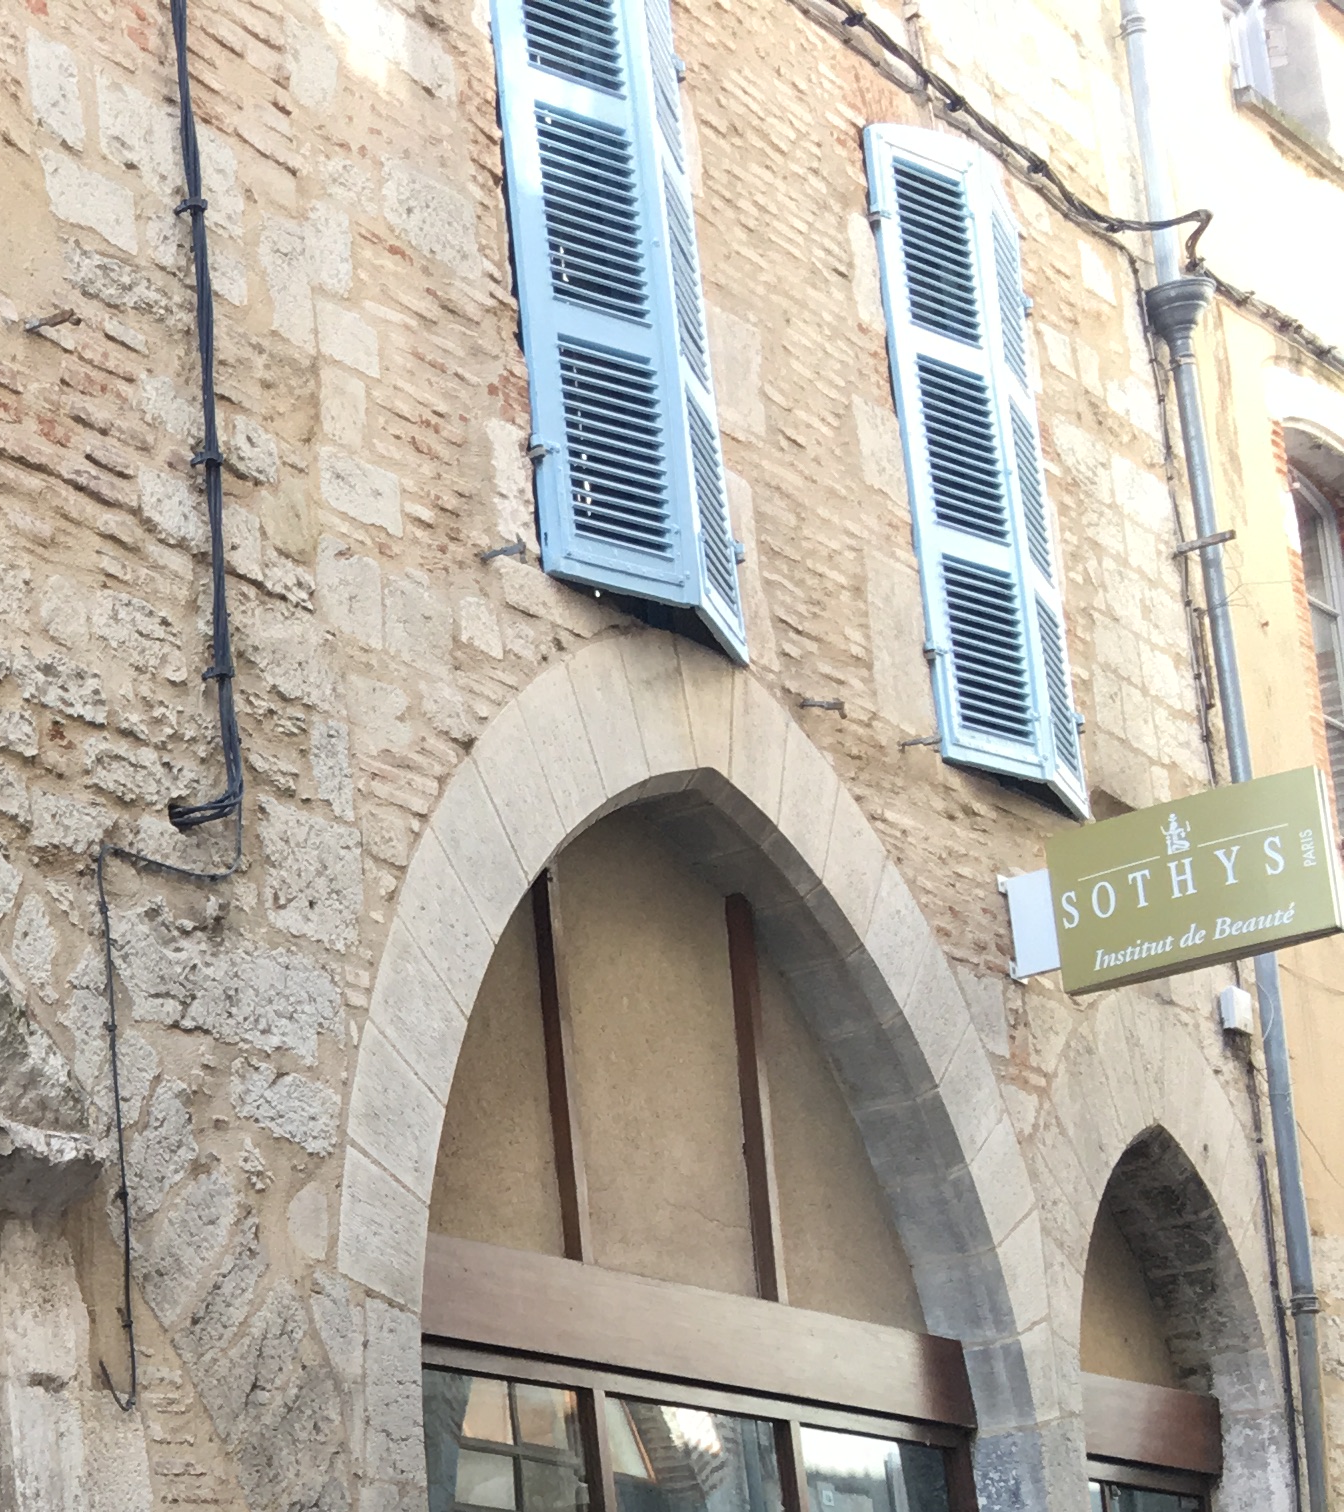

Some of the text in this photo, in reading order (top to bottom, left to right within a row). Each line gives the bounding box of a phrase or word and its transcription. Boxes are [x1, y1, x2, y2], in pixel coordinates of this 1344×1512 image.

[1060, 835, 1286, 929] SOTHYS
[1299, 828, 1317, 867] PARIS
[1093, 901, 1296, 971] Institut de Beauté
